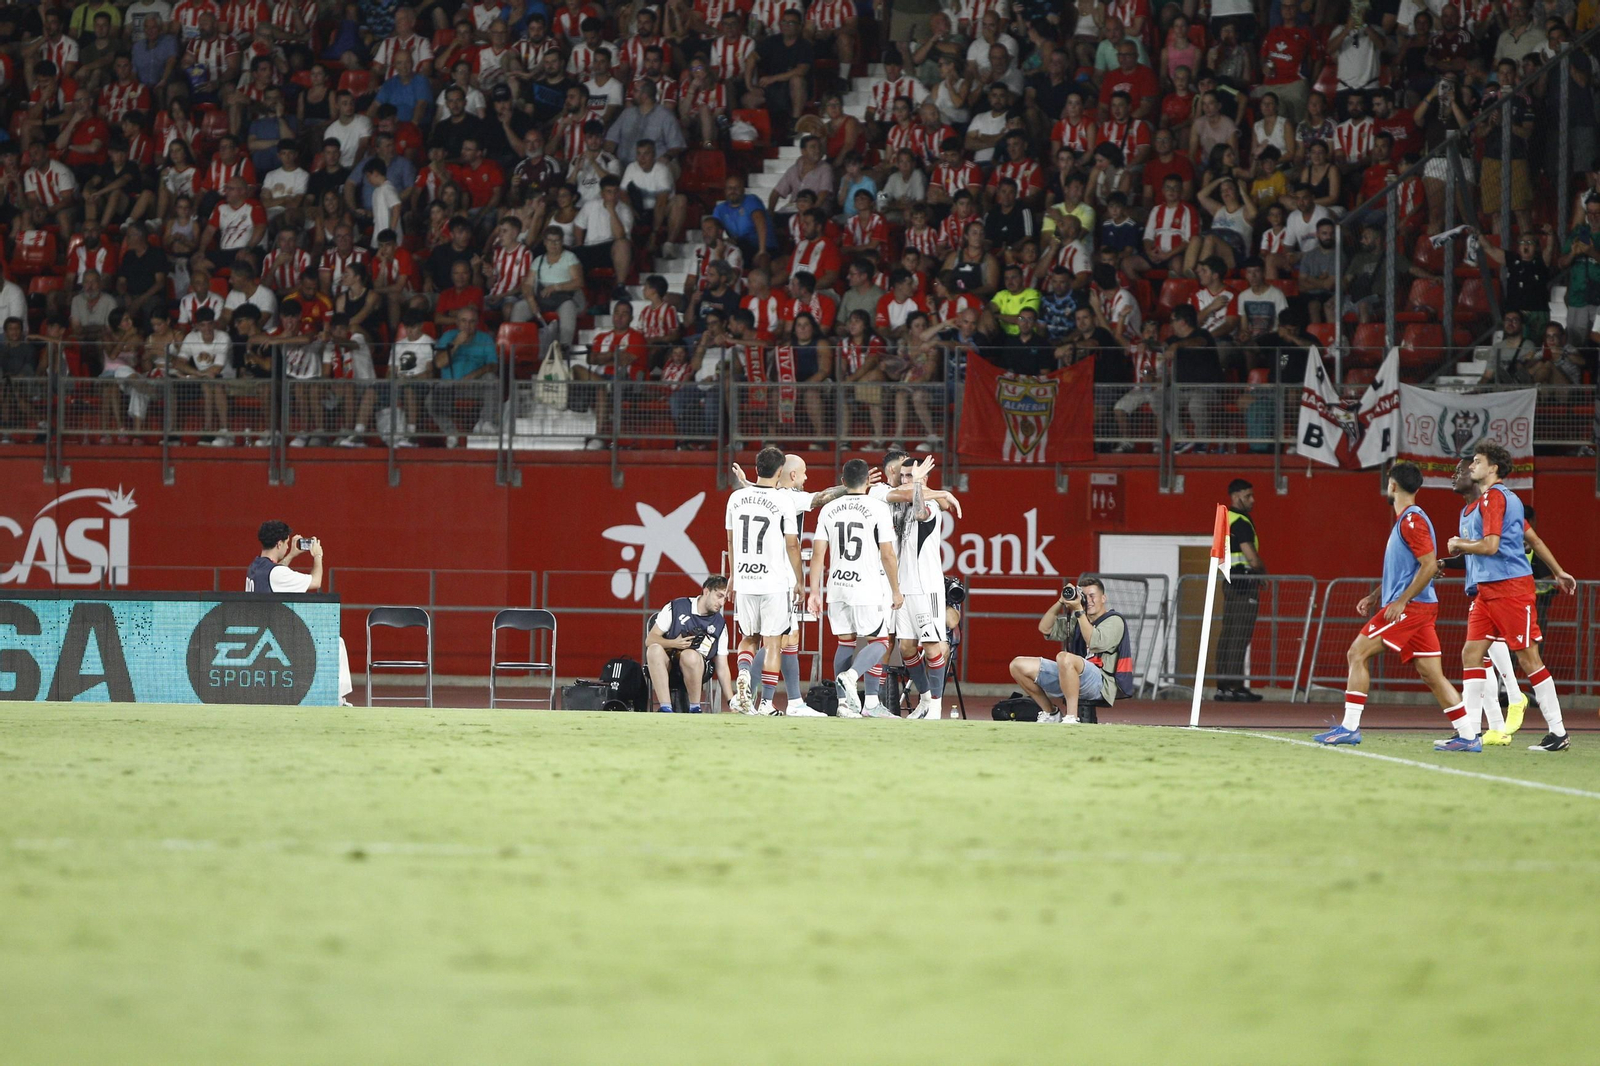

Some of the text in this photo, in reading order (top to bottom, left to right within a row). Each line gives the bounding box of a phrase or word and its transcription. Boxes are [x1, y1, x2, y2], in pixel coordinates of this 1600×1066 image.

[1303, 422, 1324, 448] B
[1405, 413, 1530, 448] 19 39
[739, 514, 771, 555] 17
[834, 521, 864, 562] 15
[211, 626, 291, 667] EA
[209, 669, 294, 688] SPORTS
